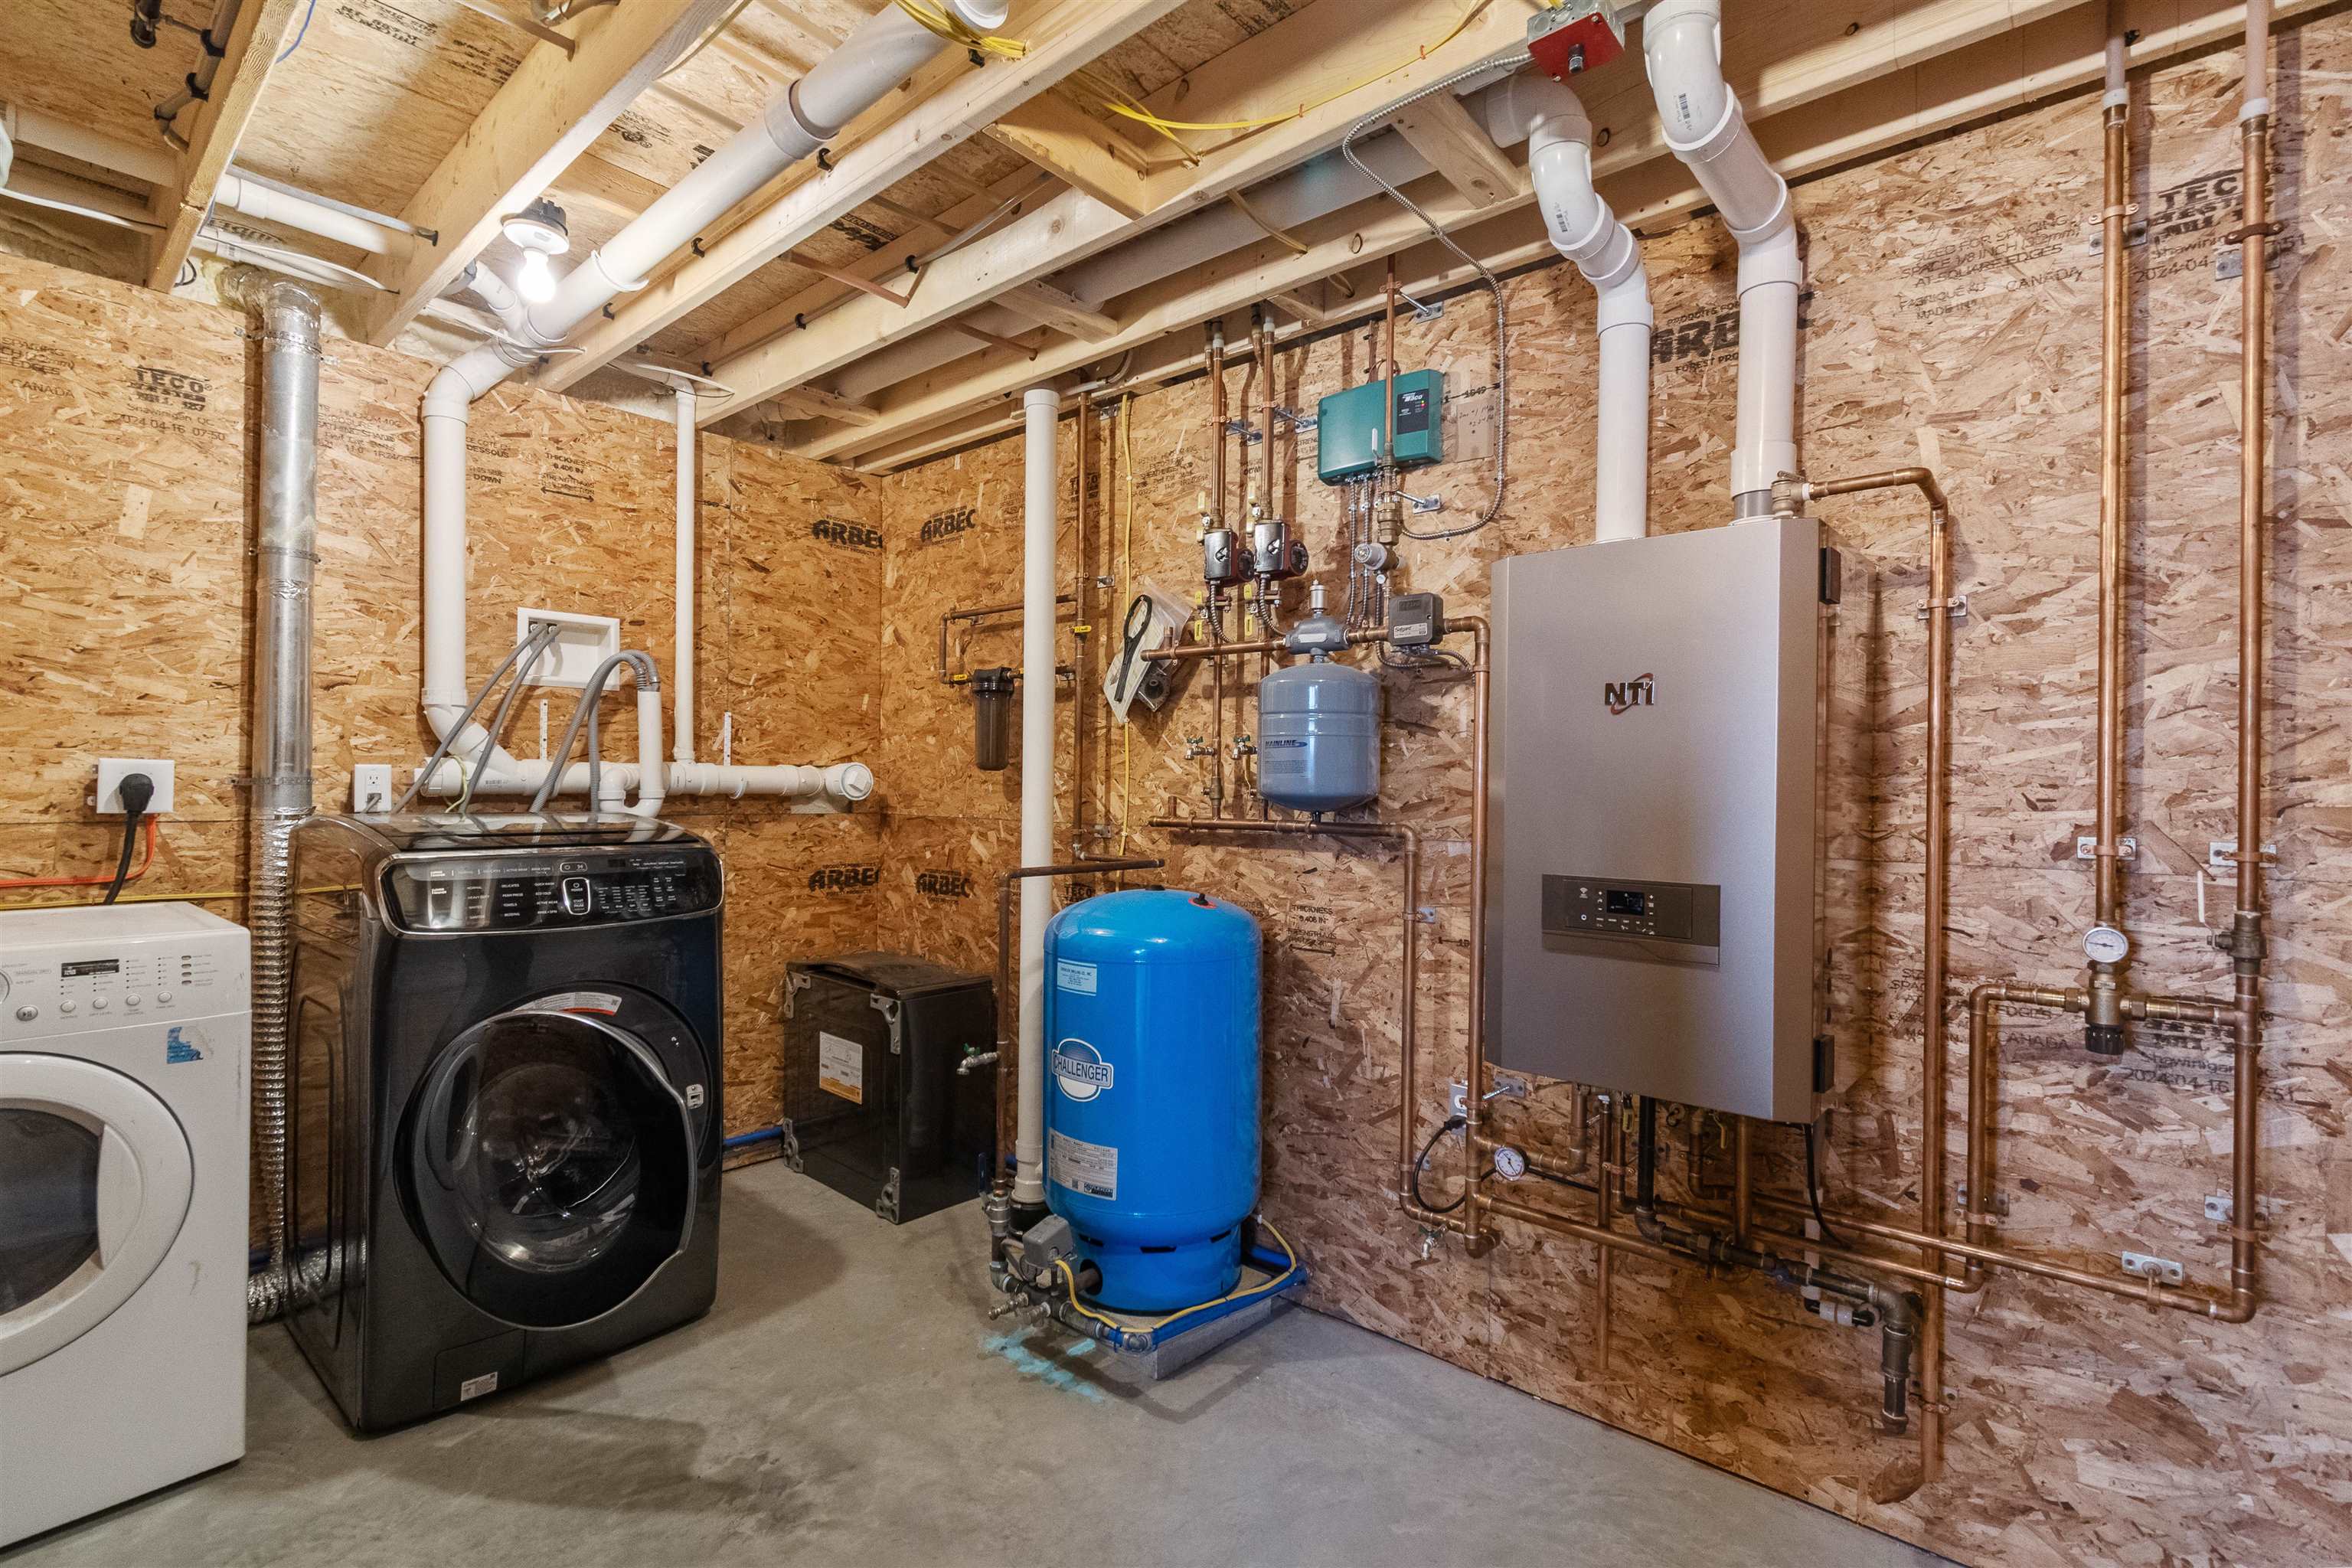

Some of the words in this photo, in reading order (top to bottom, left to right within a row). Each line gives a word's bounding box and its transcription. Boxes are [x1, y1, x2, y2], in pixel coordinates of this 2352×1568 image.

[2158, 176, 2239, 212] TEC
[135, 368, 206, 394] TECO
[812, 519, 882, 549] ARBE
[920, 508, 977, 543] ARBEC
[808, 867, 879, 893] ARBE
[1054, 1054, 1109, 1083] CHALLENGER
